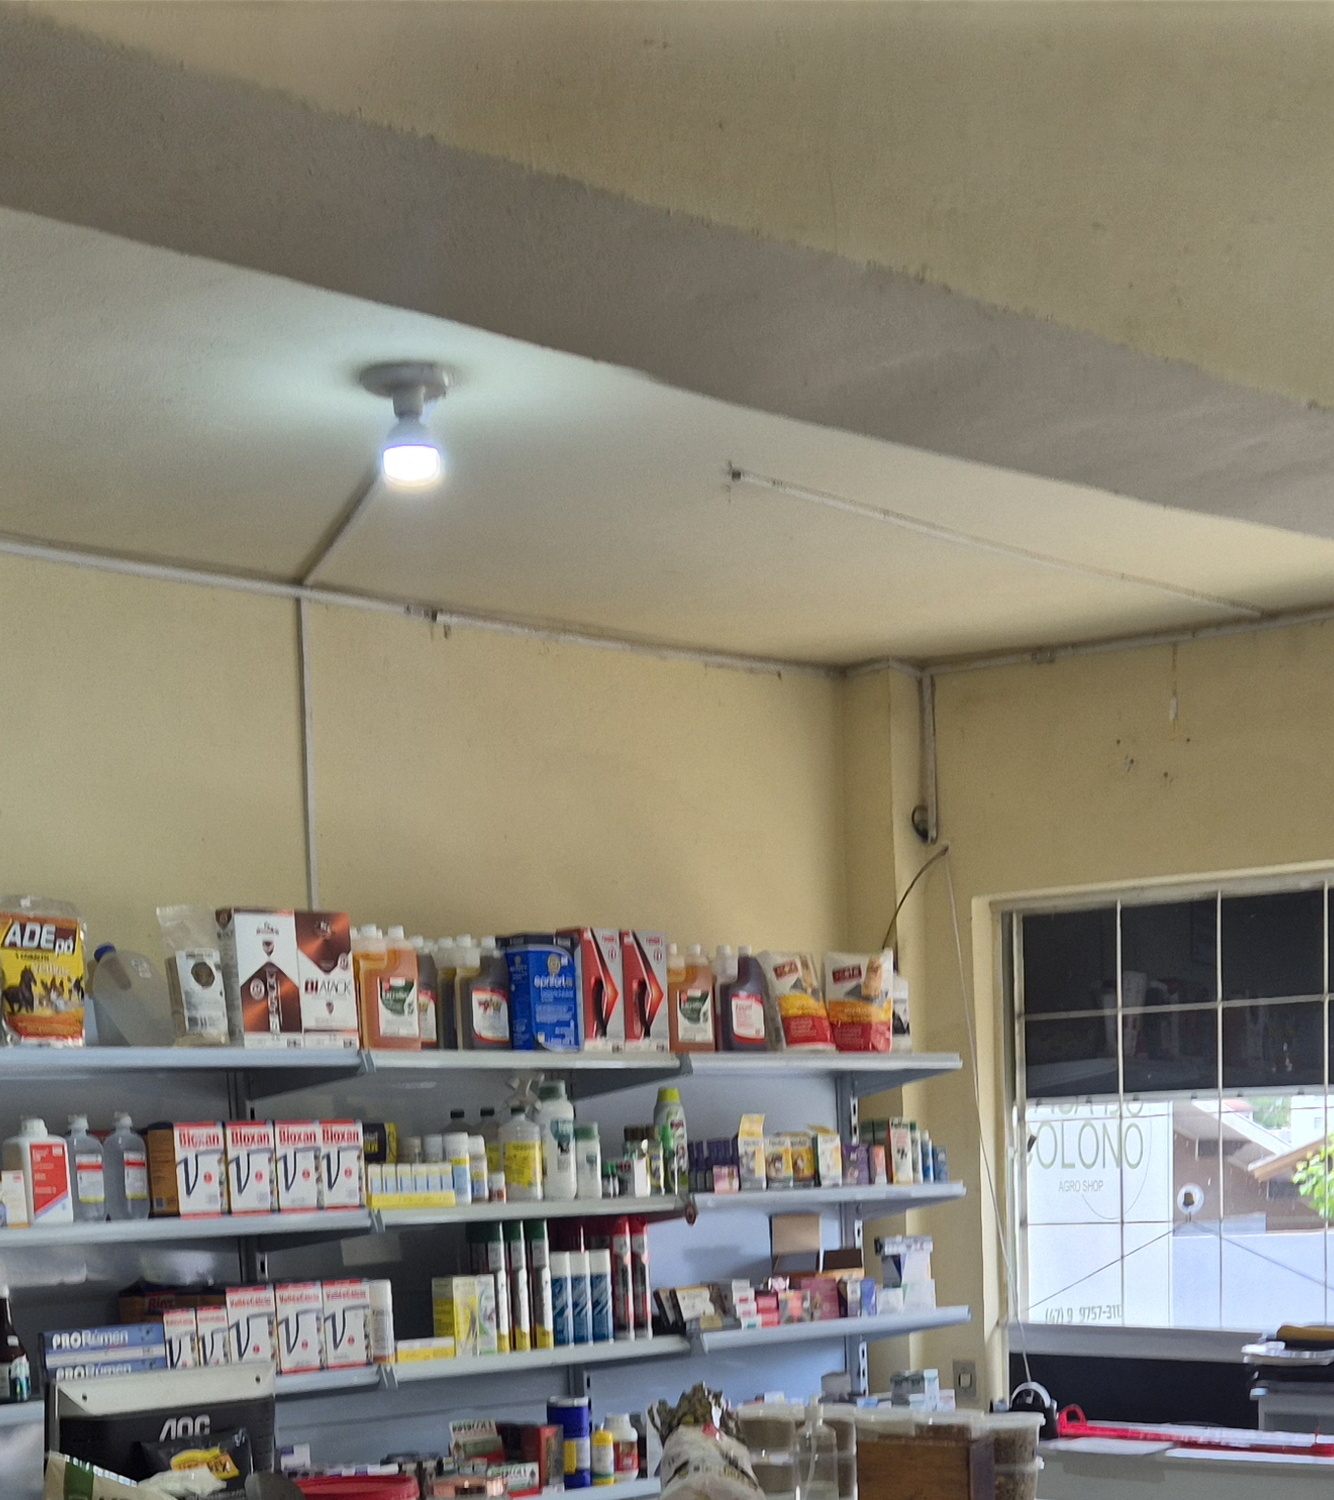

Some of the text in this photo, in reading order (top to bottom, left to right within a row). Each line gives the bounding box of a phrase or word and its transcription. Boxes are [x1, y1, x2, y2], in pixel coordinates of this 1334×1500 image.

[4, 922, 56, 950] ADE
[231, 1127, 270, 1147] Bloxan
[279, 1125, 317, 1145] Bloxan
[322, 1124, 359, 1144] Bloxan
[1058, 1180, 1104, 1193] AGRO SHOP
[159, 1414, 210, 1442] AOC
